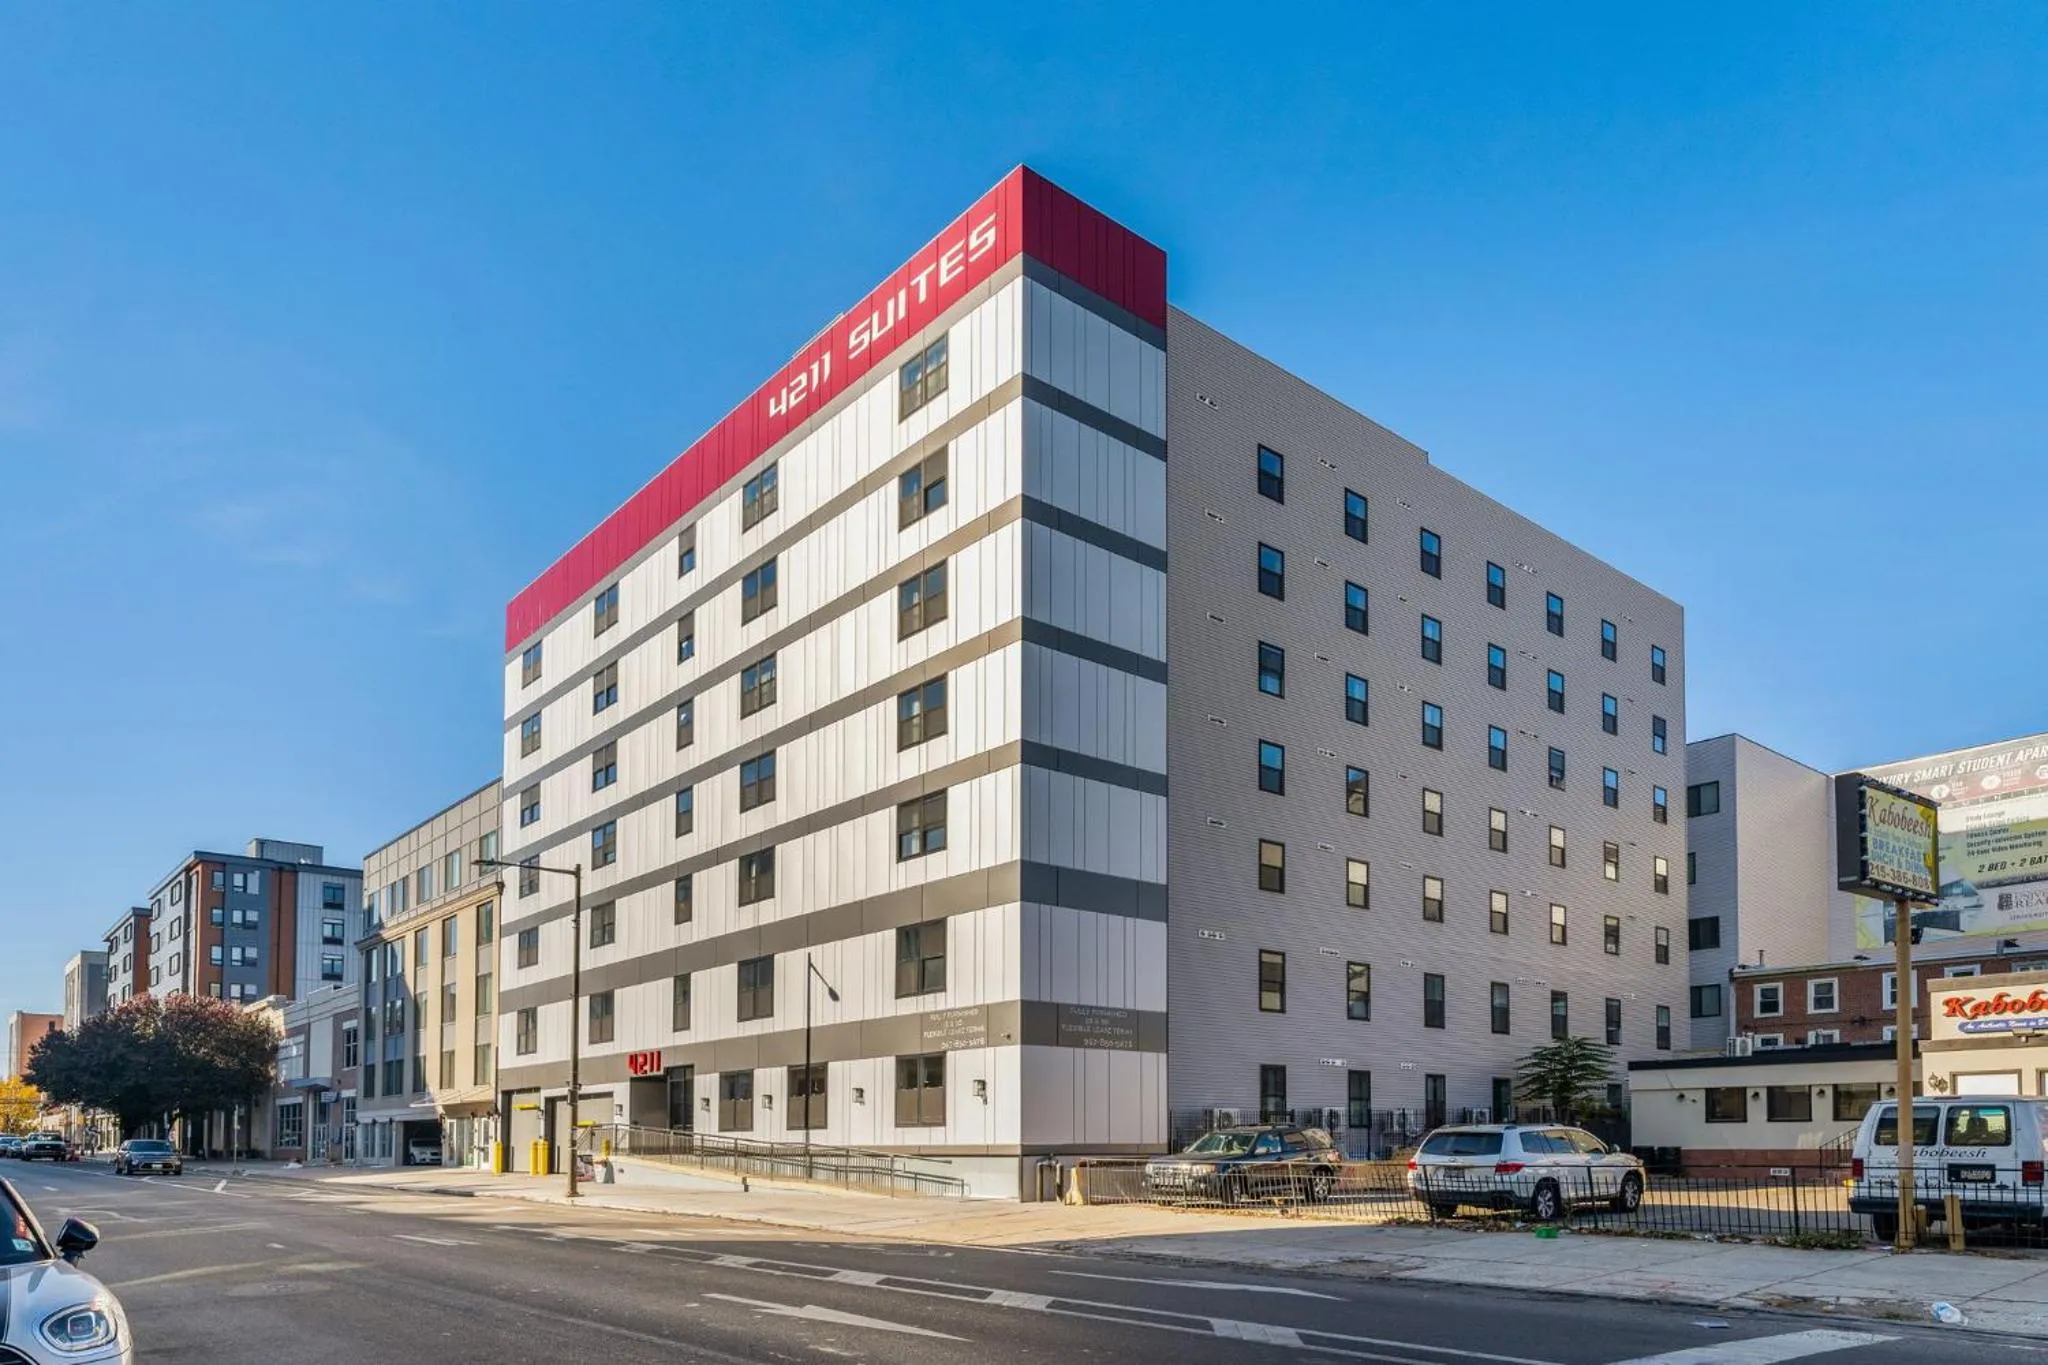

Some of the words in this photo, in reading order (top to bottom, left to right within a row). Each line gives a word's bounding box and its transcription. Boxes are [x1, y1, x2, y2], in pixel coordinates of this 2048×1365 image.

[768, 350, 832, 419] 4211
[847, 212, 997, 360] SUITES
[1913, 764, 1955, 783] SMART
[1957, 754, 2011, 774] STUDENT
[1867, 795, 1932, 839] Kabobeesh
[1977, 864, 1985, 873] 2
[1988, 860, 2007, 871] BED
[2019, 857, 2027, 867] 2
[627, 1050, 662, 1075] 4211
